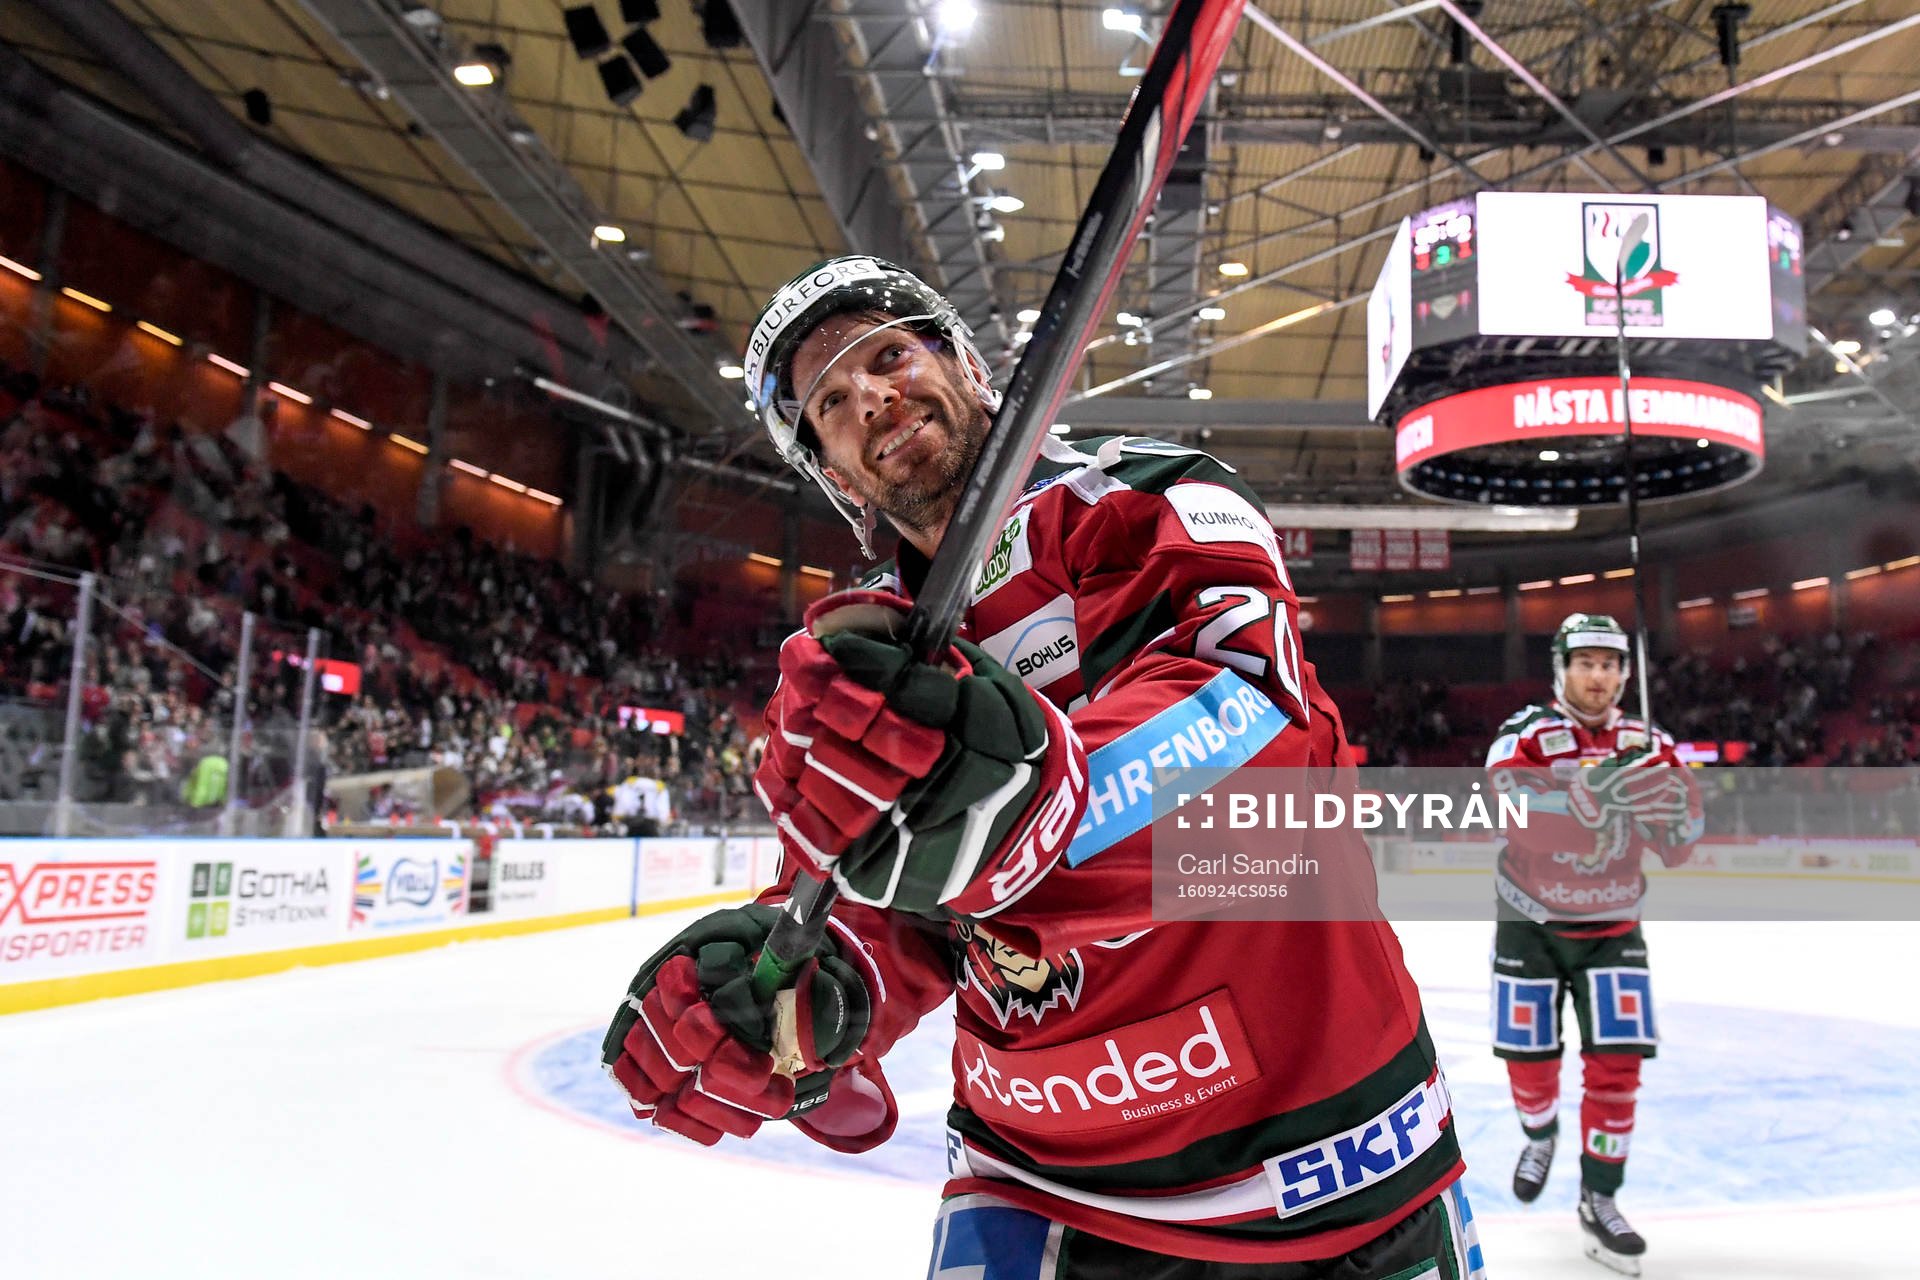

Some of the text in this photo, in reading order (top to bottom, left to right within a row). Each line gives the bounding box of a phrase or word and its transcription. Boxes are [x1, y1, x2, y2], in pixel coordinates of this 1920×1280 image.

[752, 263, 871, 357] BJURFORS
[1514, 386, 1608, 428] NÄSTA
[1016, 634, 1076, 677] BOHUS
[1539, 879, 1640, 905] xtended
[963, 1005, 1231, 1114] xtended
[1121, 1075, 1238, 1121] Business & Event
[1279, 1091, 1425, 1210] SKF
